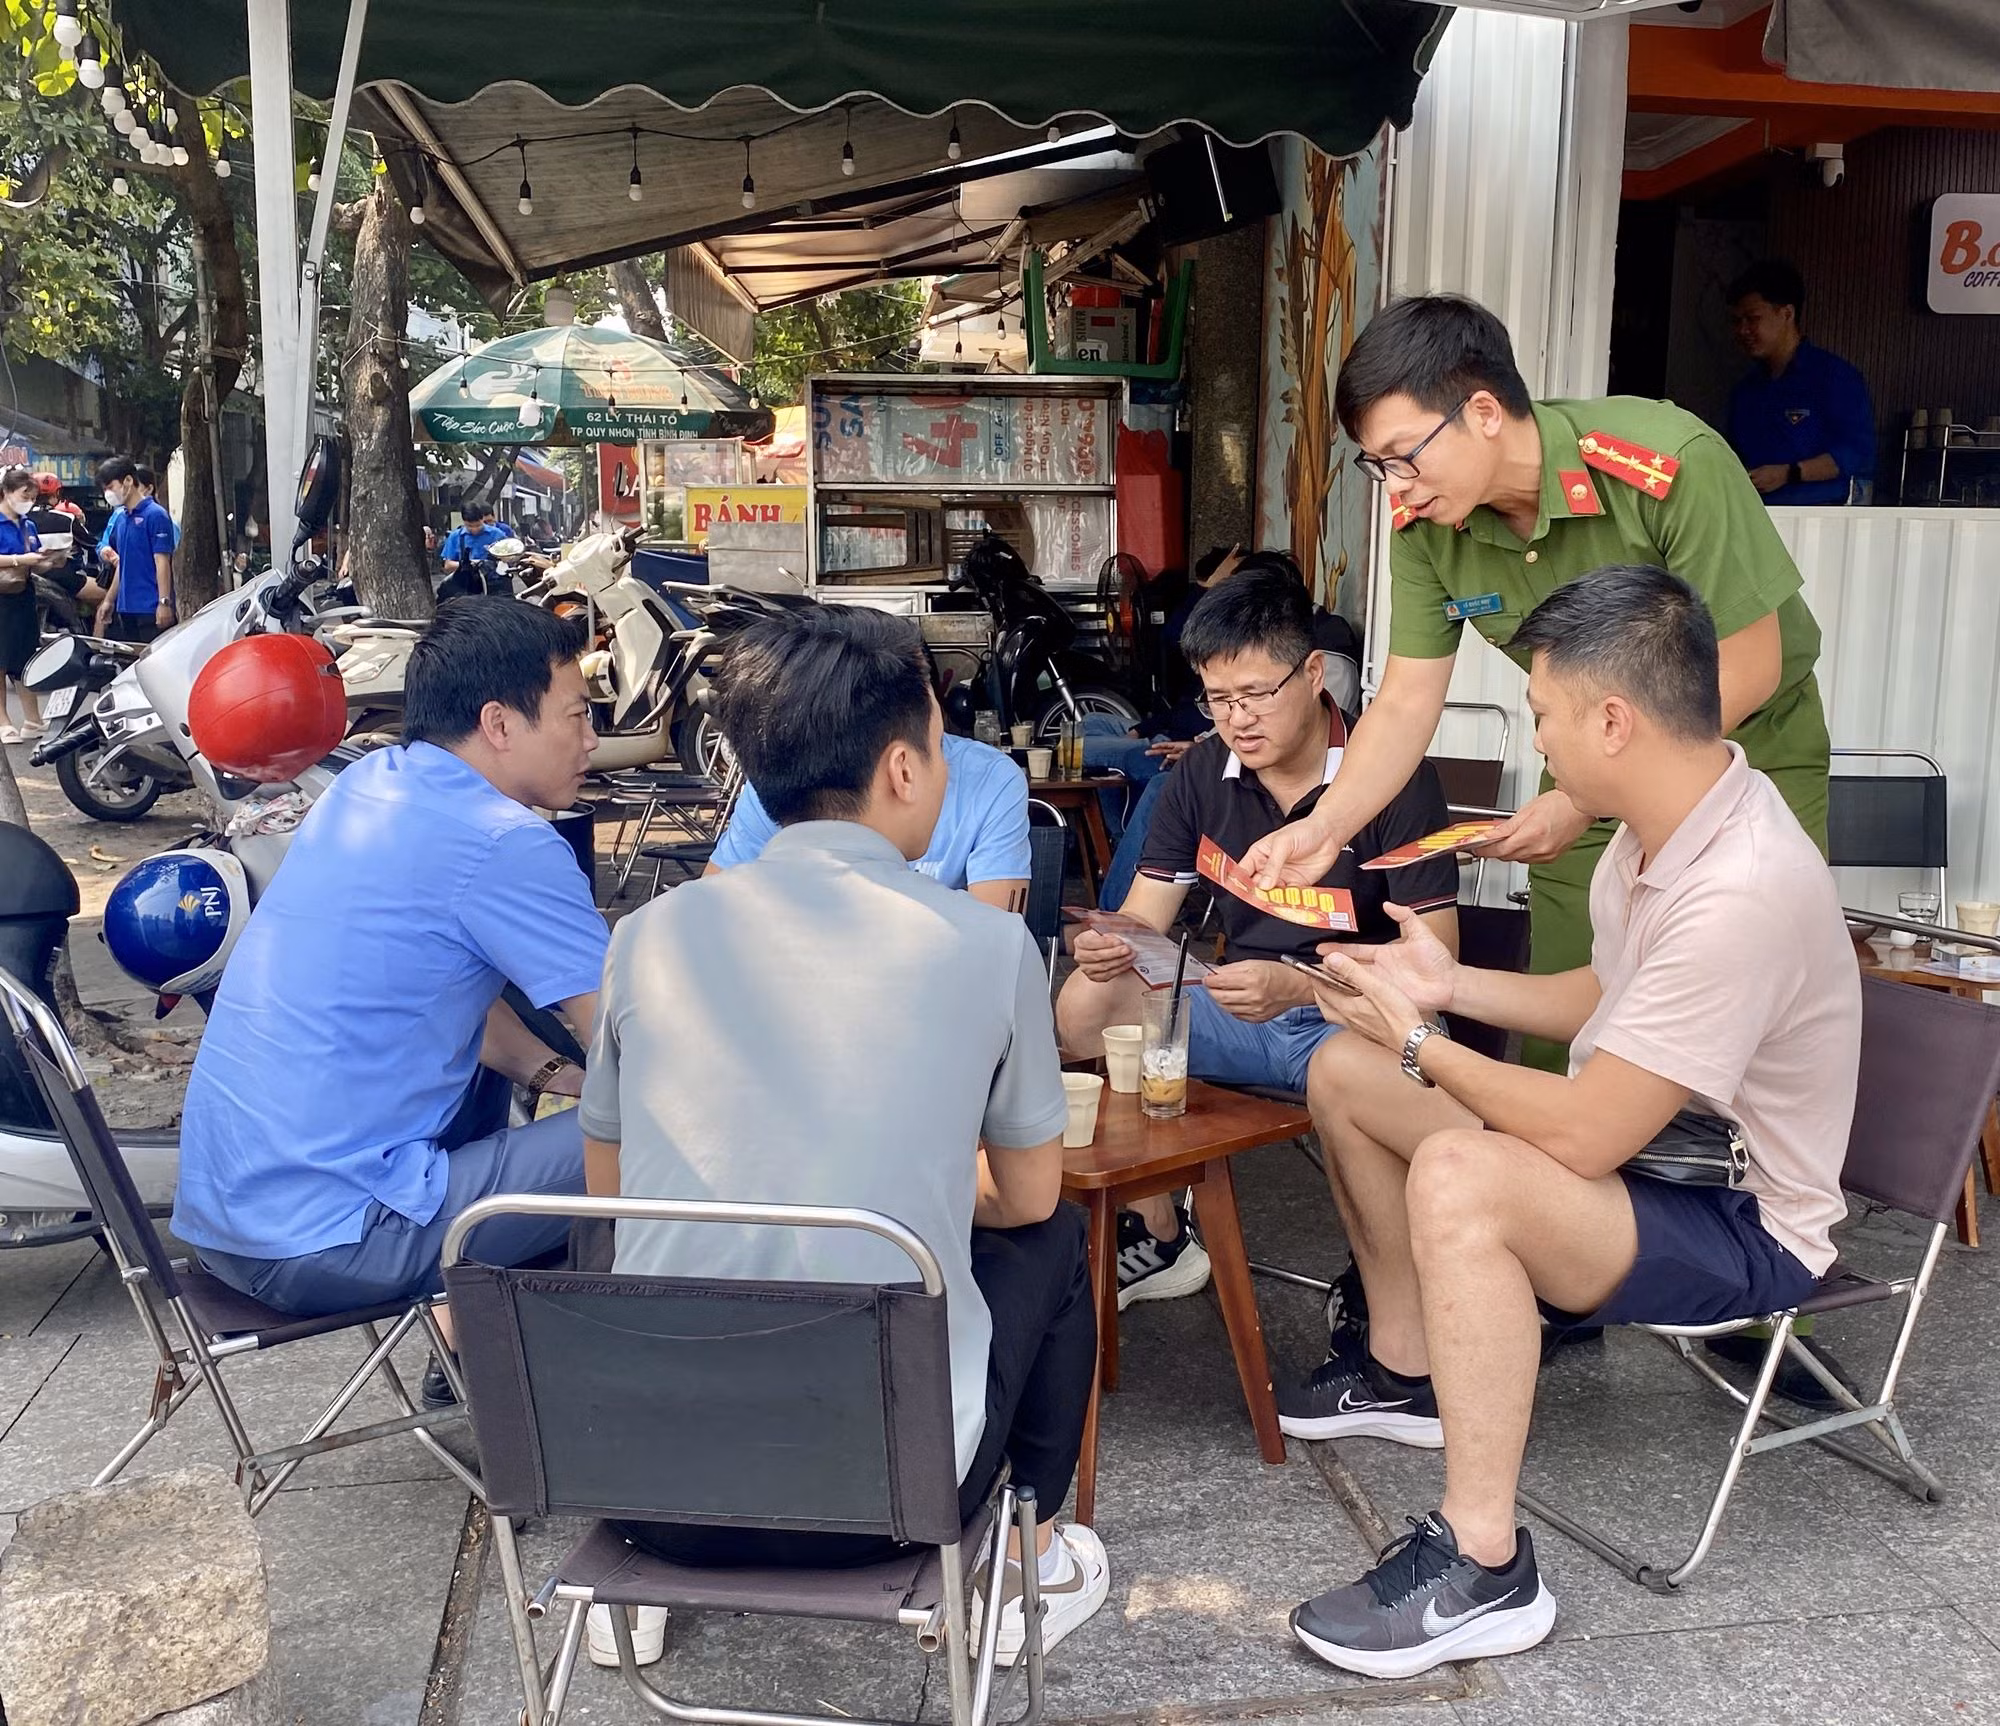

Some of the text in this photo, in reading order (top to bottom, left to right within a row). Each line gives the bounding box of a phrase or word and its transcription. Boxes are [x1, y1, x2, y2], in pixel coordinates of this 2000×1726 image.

[586, 412, 601, 422] 62
[626, 412, 656, 424] THÁI
[571, 428, 583, 436] TP
[585, 428, 606, 438] QUY
[694, 495, 782, 532] BÁNH
[200, 886, 222, 917] PNJ
